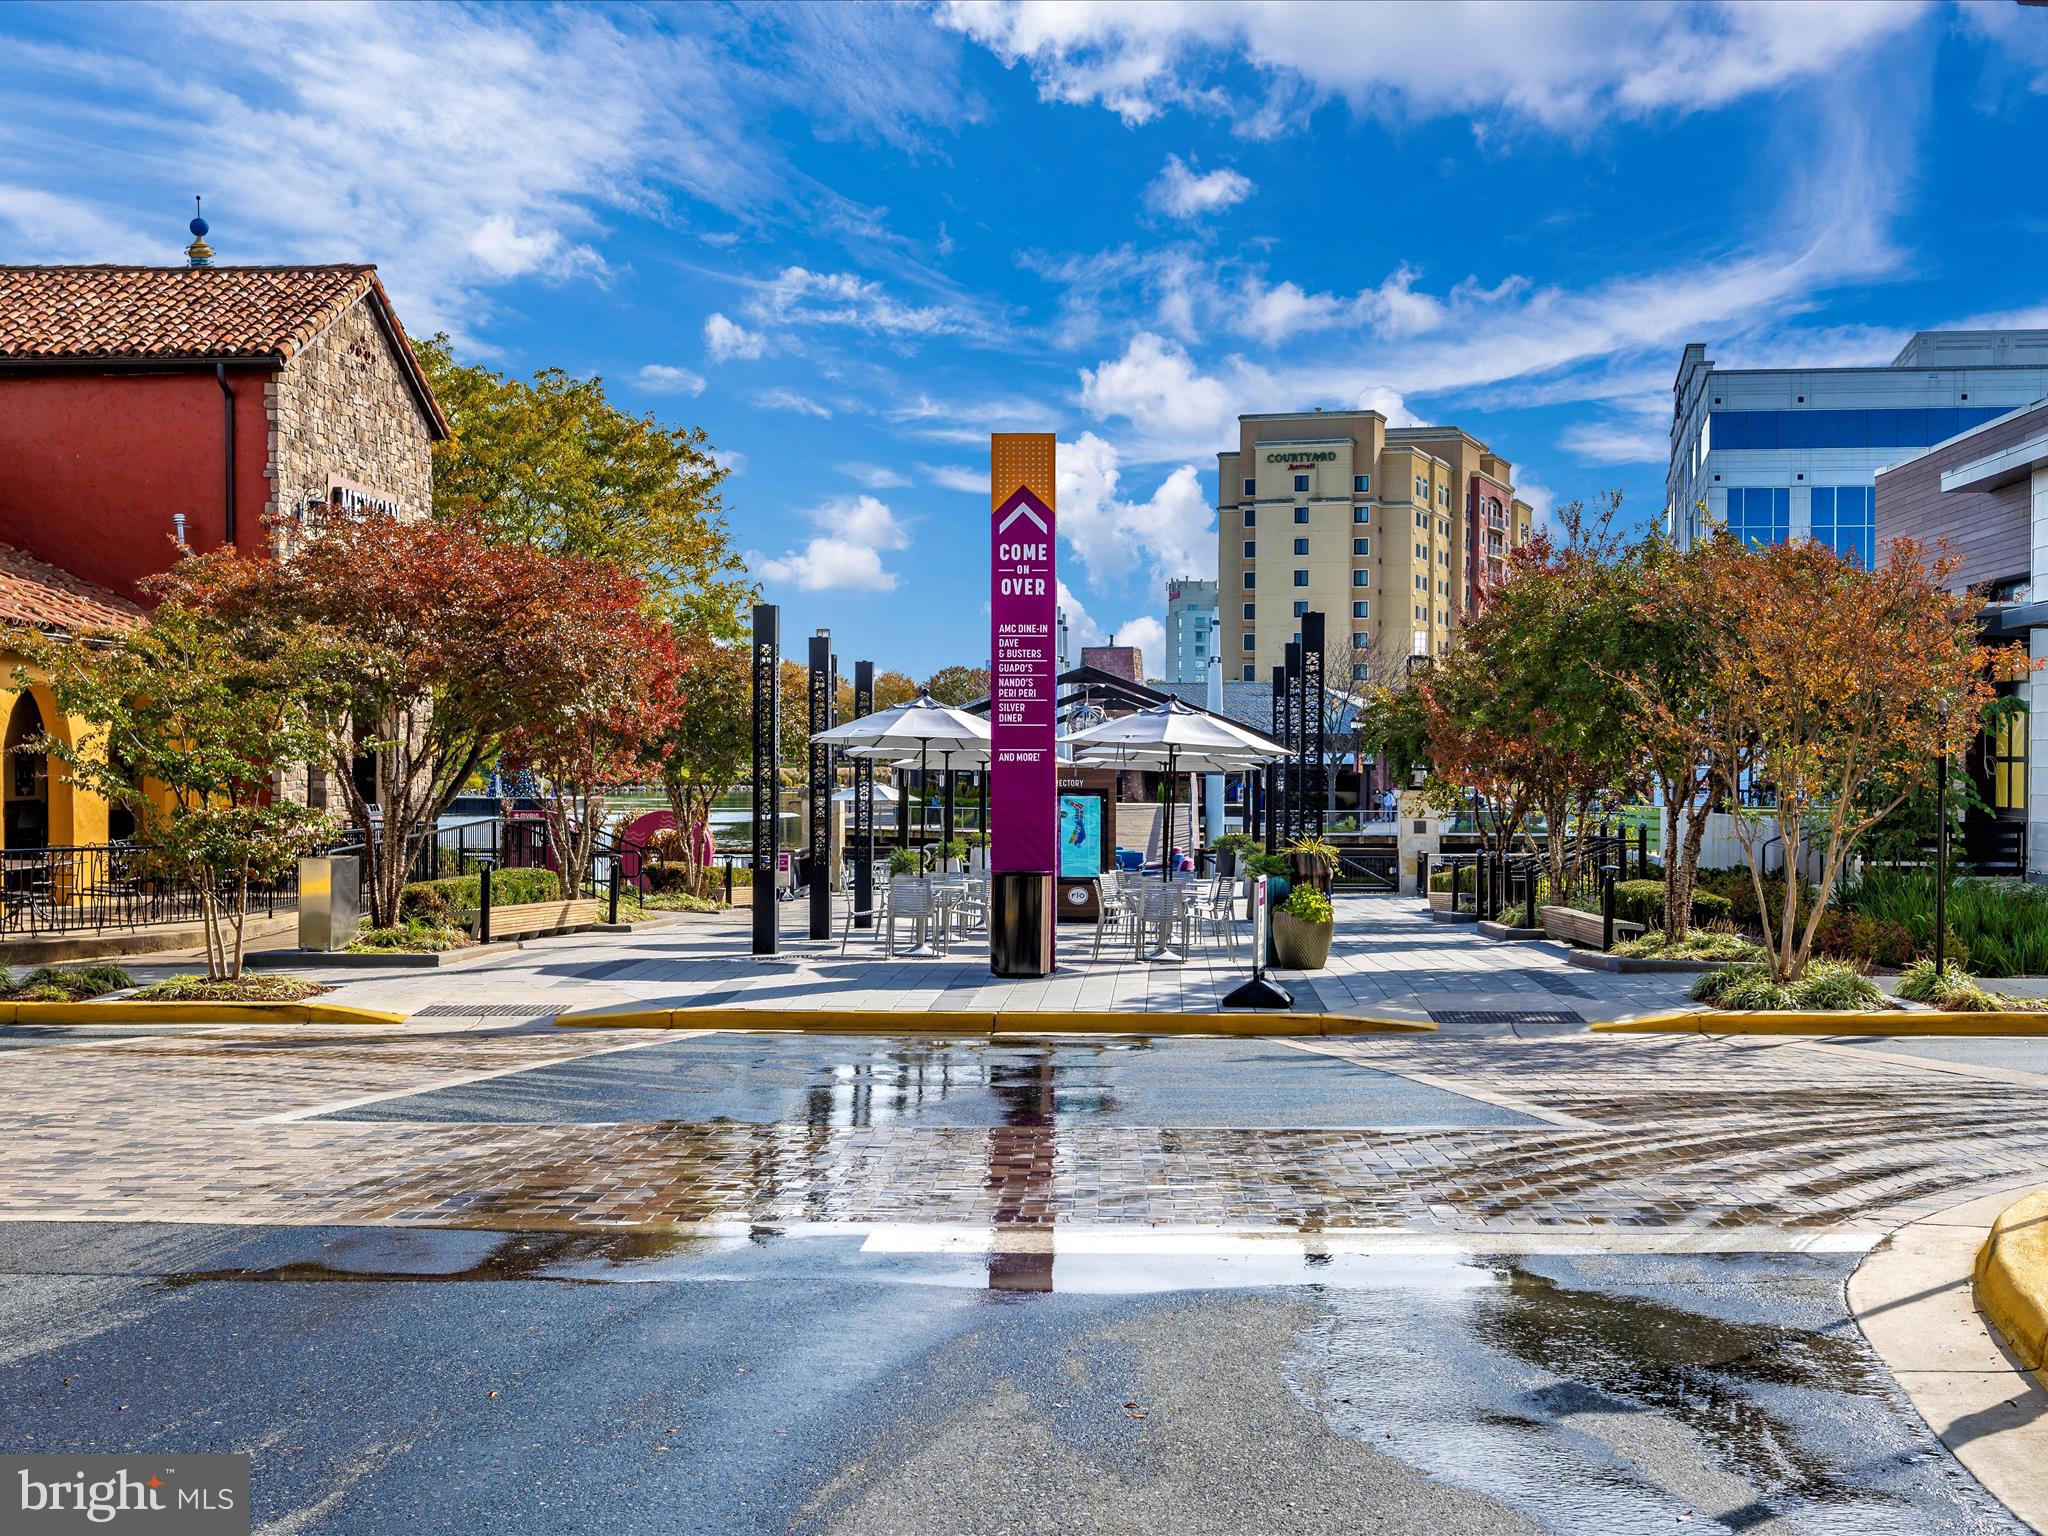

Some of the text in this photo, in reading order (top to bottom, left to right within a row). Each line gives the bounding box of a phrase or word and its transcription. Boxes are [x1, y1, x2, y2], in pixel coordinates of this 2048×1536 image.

[1267, 451, 1336, 463] COURTYARD
[999, 543, 1047, 561] COME
[1016, 564, 1030, 575] ON
[1001, 578, 1046, 596] OVER
[999, 624, 1048, 634] AMC DINE-IN
[998, 638, 1019, 648] DAVE
[998, 649, 1042, 658] & BUSTERS
[998, 663, 1033, 673] GUAPO'S
[998, 678, 1034, 687] NANDO'S
[998, 688, 1037, 698] PERI PERI
[998, 703, 1025, 712] SILVER
[998, 713, 1023, 723] DINER
[998, 753, 1040, 762] AND MORE!
[1071, 891, 1086, 899] rio
